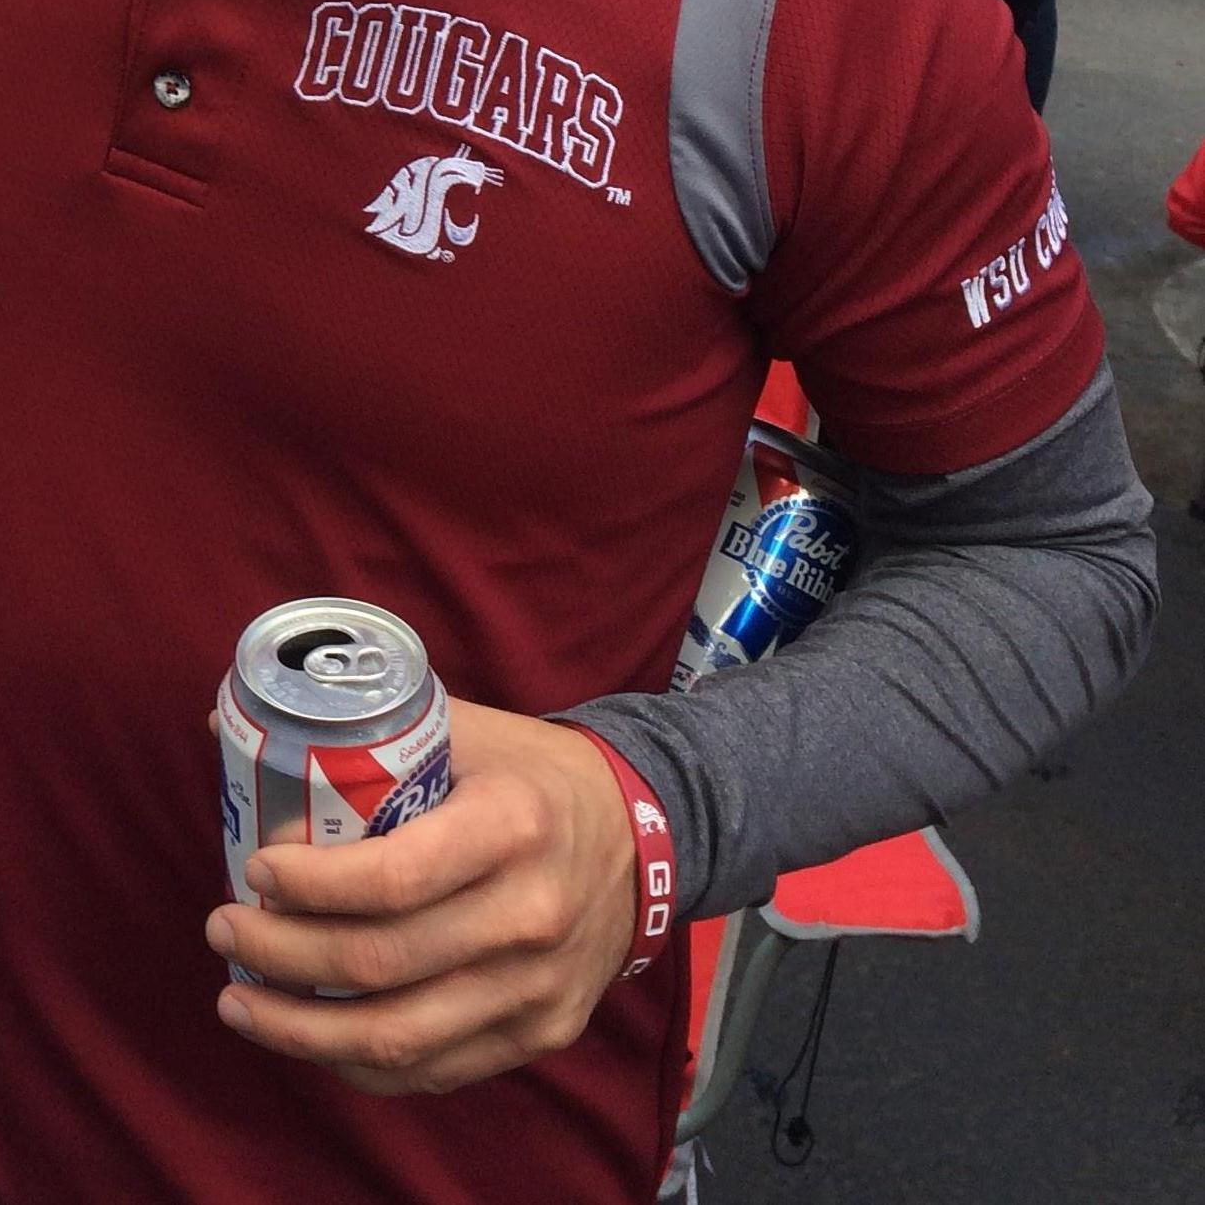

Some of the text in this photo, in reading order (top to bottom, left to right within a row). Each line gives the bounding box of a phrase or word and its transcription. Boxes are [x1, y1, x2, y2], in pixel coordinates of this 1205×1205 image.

[294, 0, 624, 189] COUGARS
[960, 236, 1031, 329] WSU
[724, 525, 836, 604] Blue Ribb
[774, 508, 850, 570] Pabst
[645, 860, 672, 938] GO
